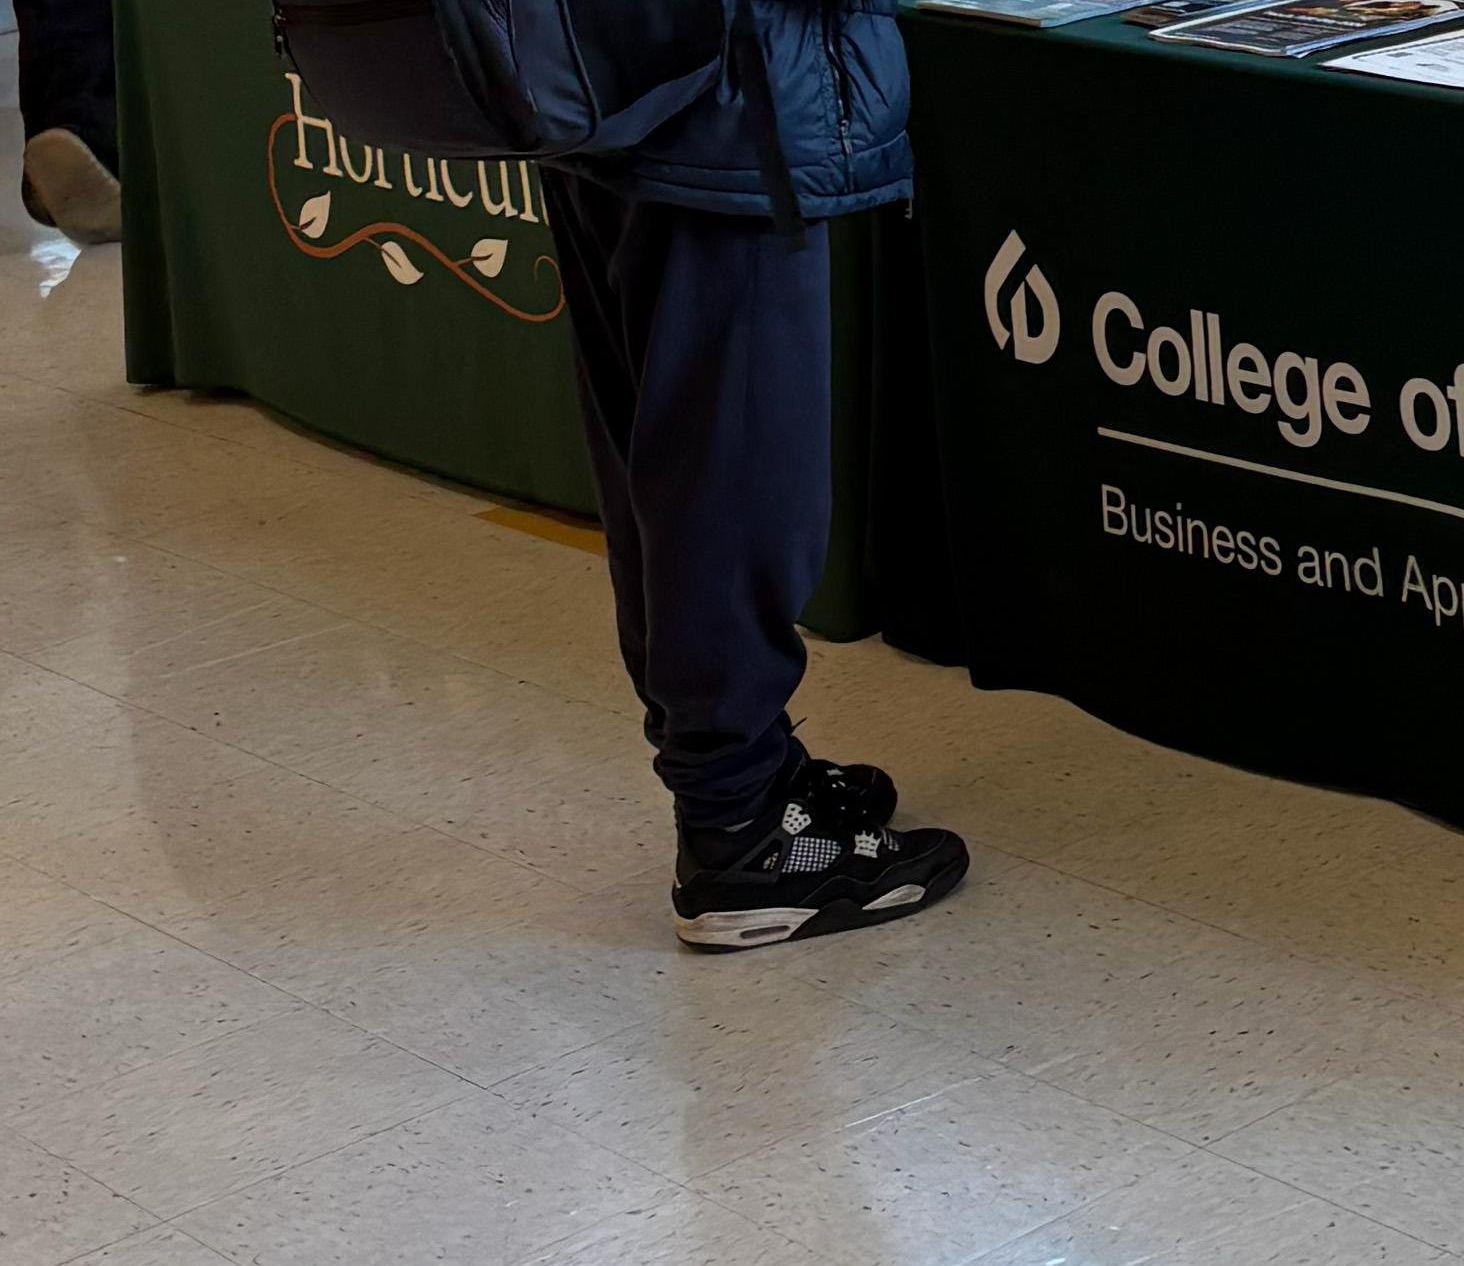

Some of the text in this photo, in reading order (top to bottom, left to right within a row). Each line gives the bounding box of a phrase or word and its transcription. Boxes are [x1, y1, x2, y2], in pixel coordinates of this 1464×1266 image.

[285, 73, 549, 226] Horticul
[1091, 290, 1372, 449] College
[1100, 484, 1283, 576] Business
[1297, 539, 1385, 598] and
